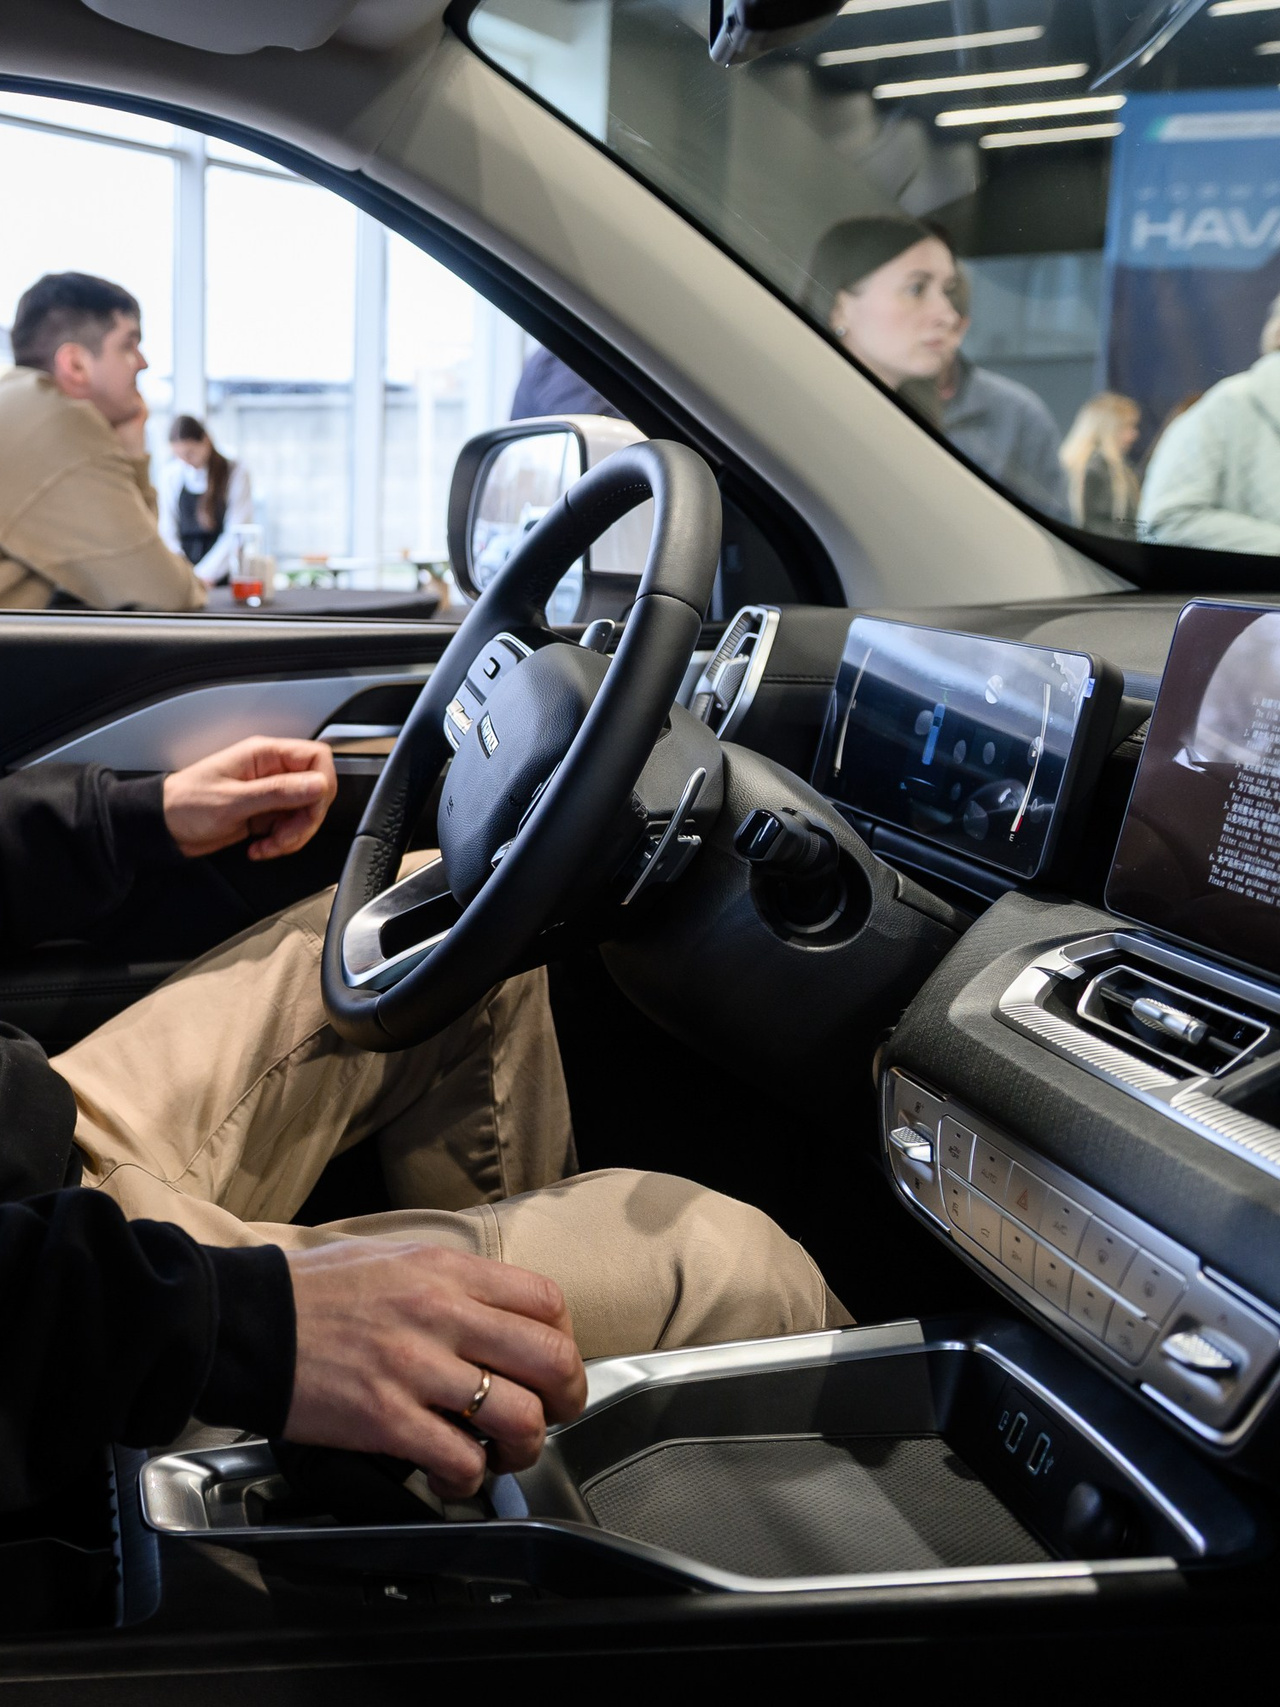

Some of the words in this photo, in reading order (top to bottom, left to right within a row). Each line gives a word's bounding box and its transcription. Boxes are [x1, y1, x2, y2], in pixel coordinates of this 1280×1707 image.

[1133, 206, 1280, 250] HAV
[1208, 875, 1225, 888] Please
[1227, 881, 1245, 894] follow
